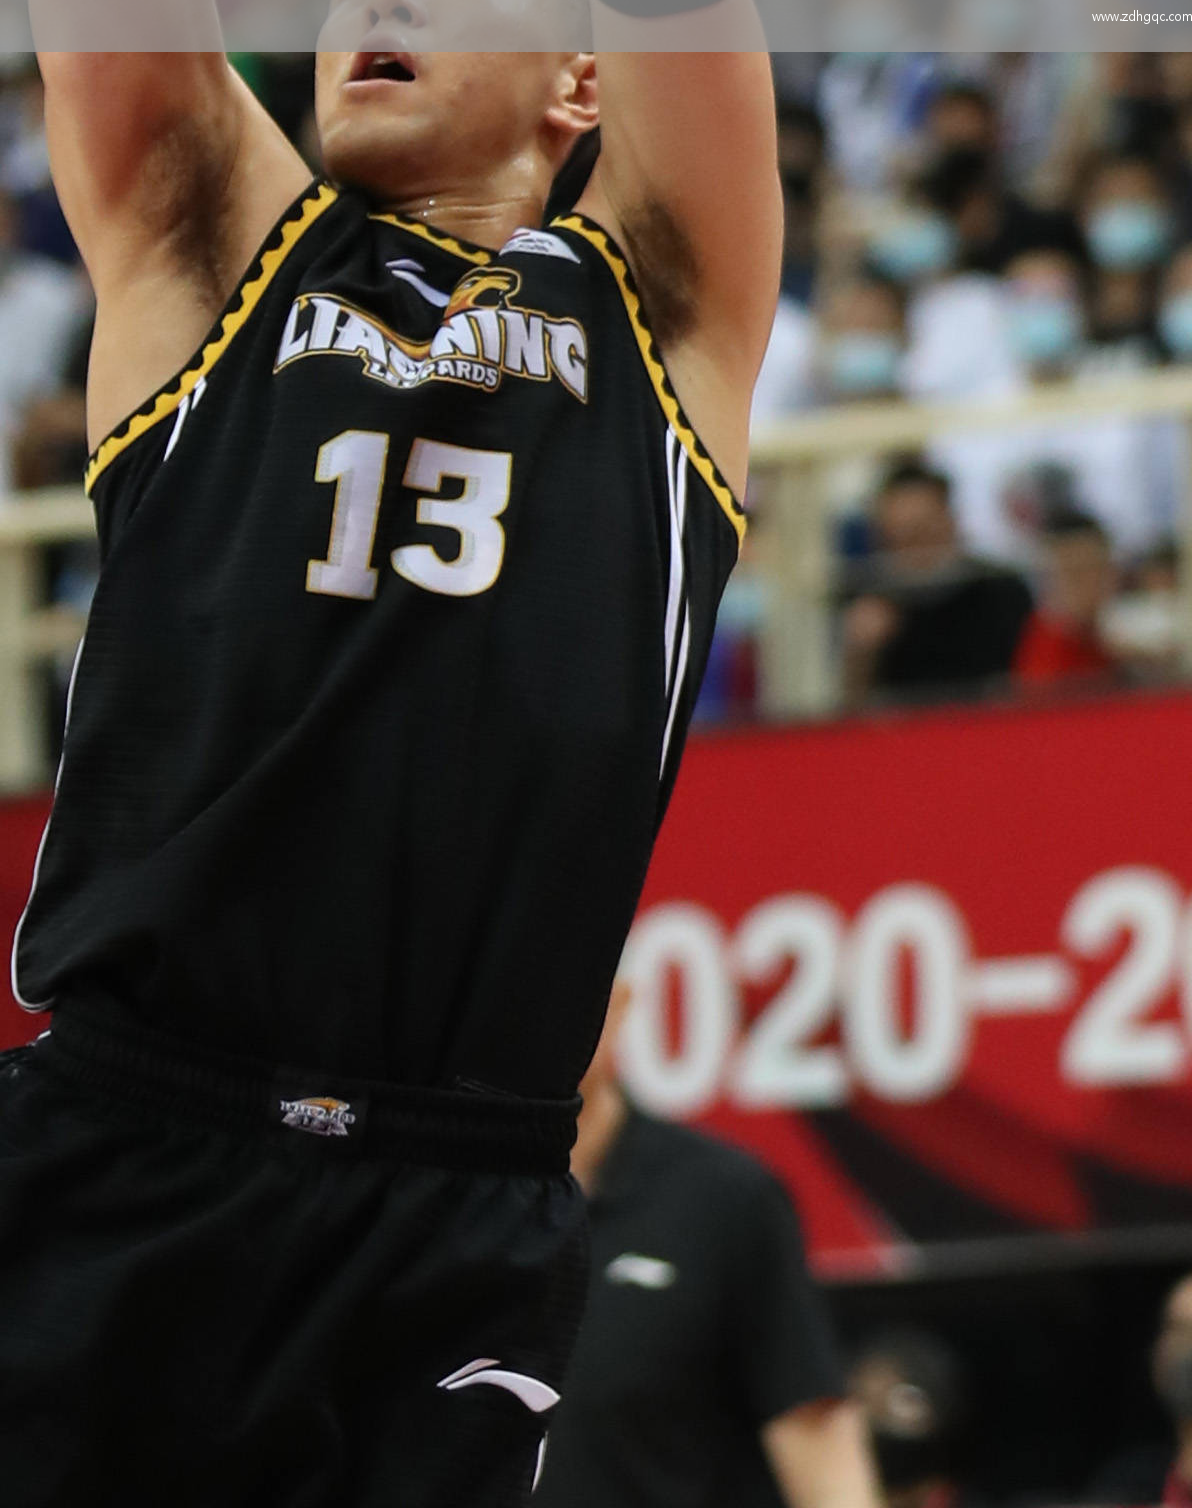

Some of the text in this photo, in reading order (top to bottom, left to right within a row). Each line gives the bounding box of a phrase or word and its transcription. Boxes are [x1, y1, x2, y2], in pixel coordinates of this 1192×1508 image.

[365, 356, 499, 390] LPARDS
[306, 429, 512, 599] 13
[614, 862, 1192, 1122] 020-2
